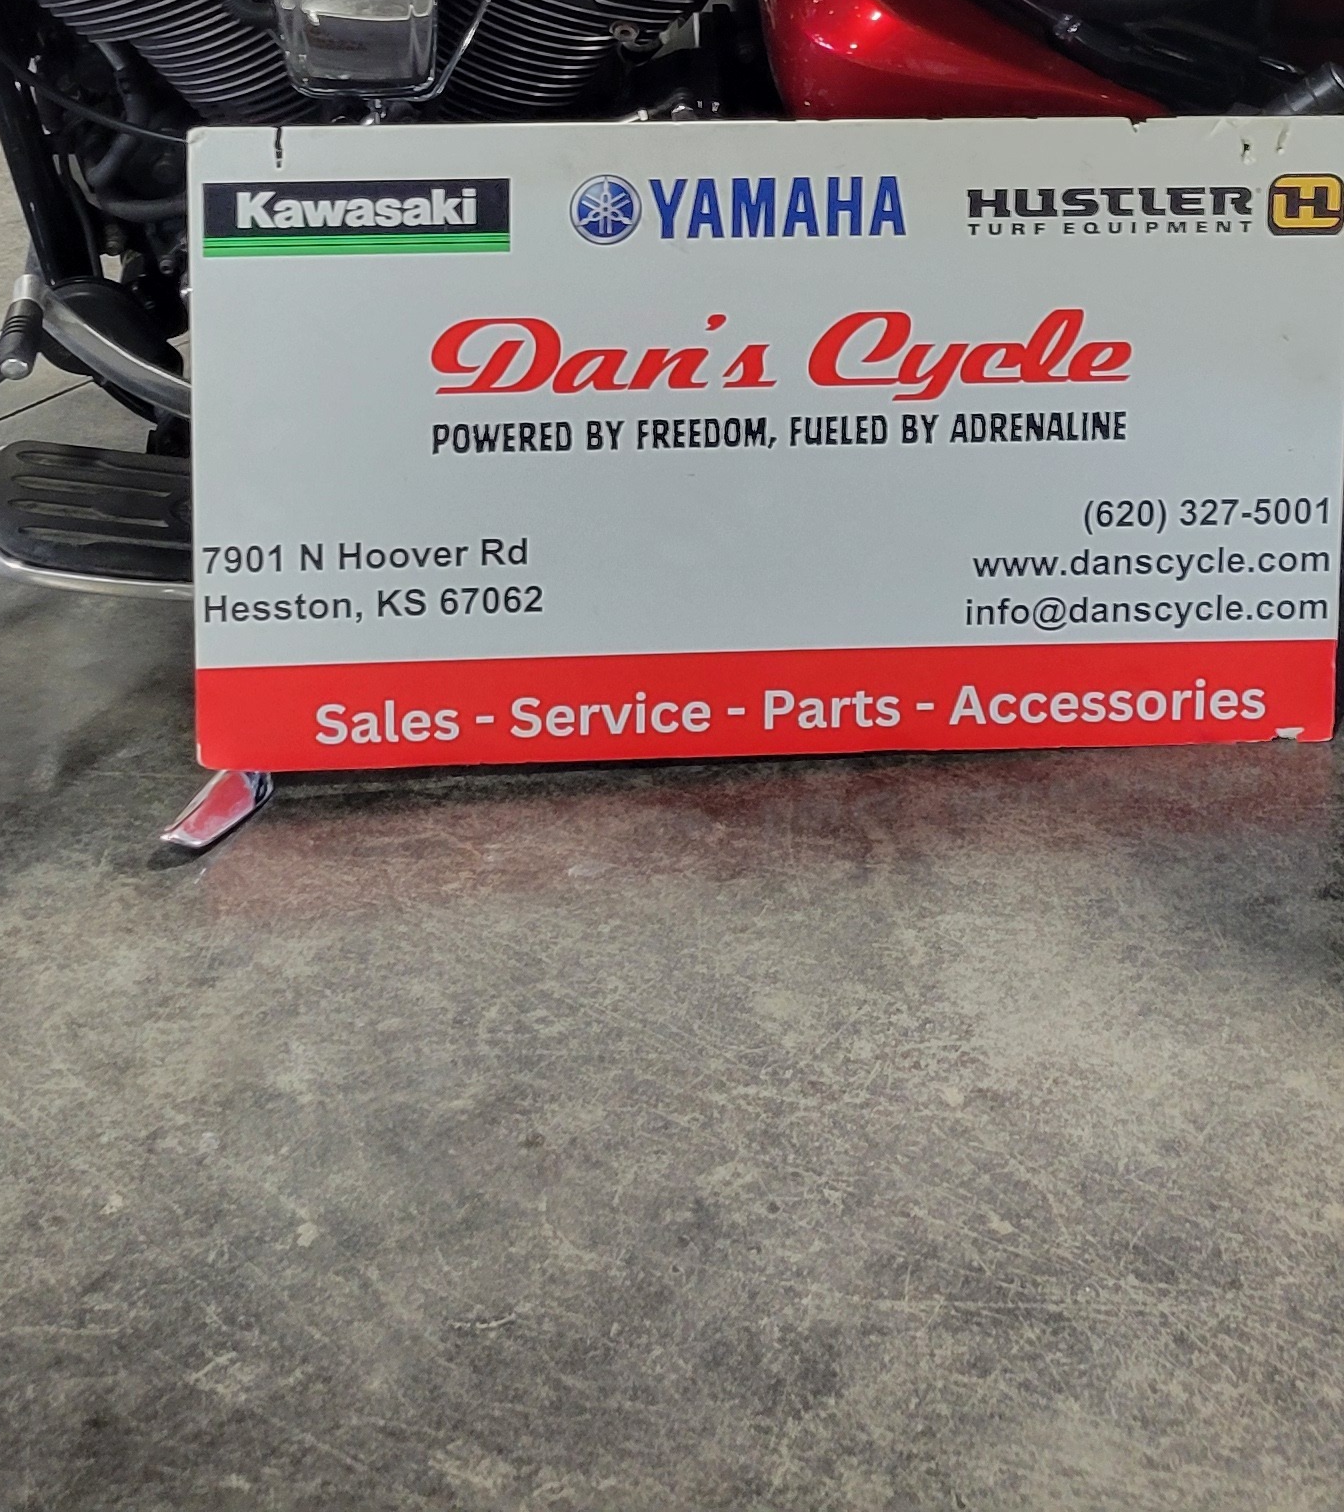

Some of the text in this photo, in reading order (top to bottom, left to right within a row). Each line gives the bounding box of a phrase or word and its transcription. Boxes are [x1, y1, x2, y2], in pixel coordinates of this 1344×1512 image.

[235, 187, 478, 230] Kawasaki
[649, 174, 906, 240] YAMAHA
[965, 185, 1253, 217] HUSTLER
[966, 219, 1253, 237] TURF EQUIPMENT
[429, 307, 1133, 402] Dan's Cycle
[431, 410, 1128, 456] POWERED BY FREEDOM, FUELED BY ADRENALINE
[1083, 496, 1329, 536] (620) 327-5001
[201, 536, 529, 575] 7901 N Hoover Rd
[971, 545, 1330, 582] www.danscycle.com
[203, 584, 544, 625] Hesston, KS 67062
[965, 593, 1329, 632] info@danscycle.com
[314, 698, 461, 746] Sales
[509, 690, 712, 739] Service
[763, 689, 902, 731] Parts
[948, 677, 1267, 726] Accessories
